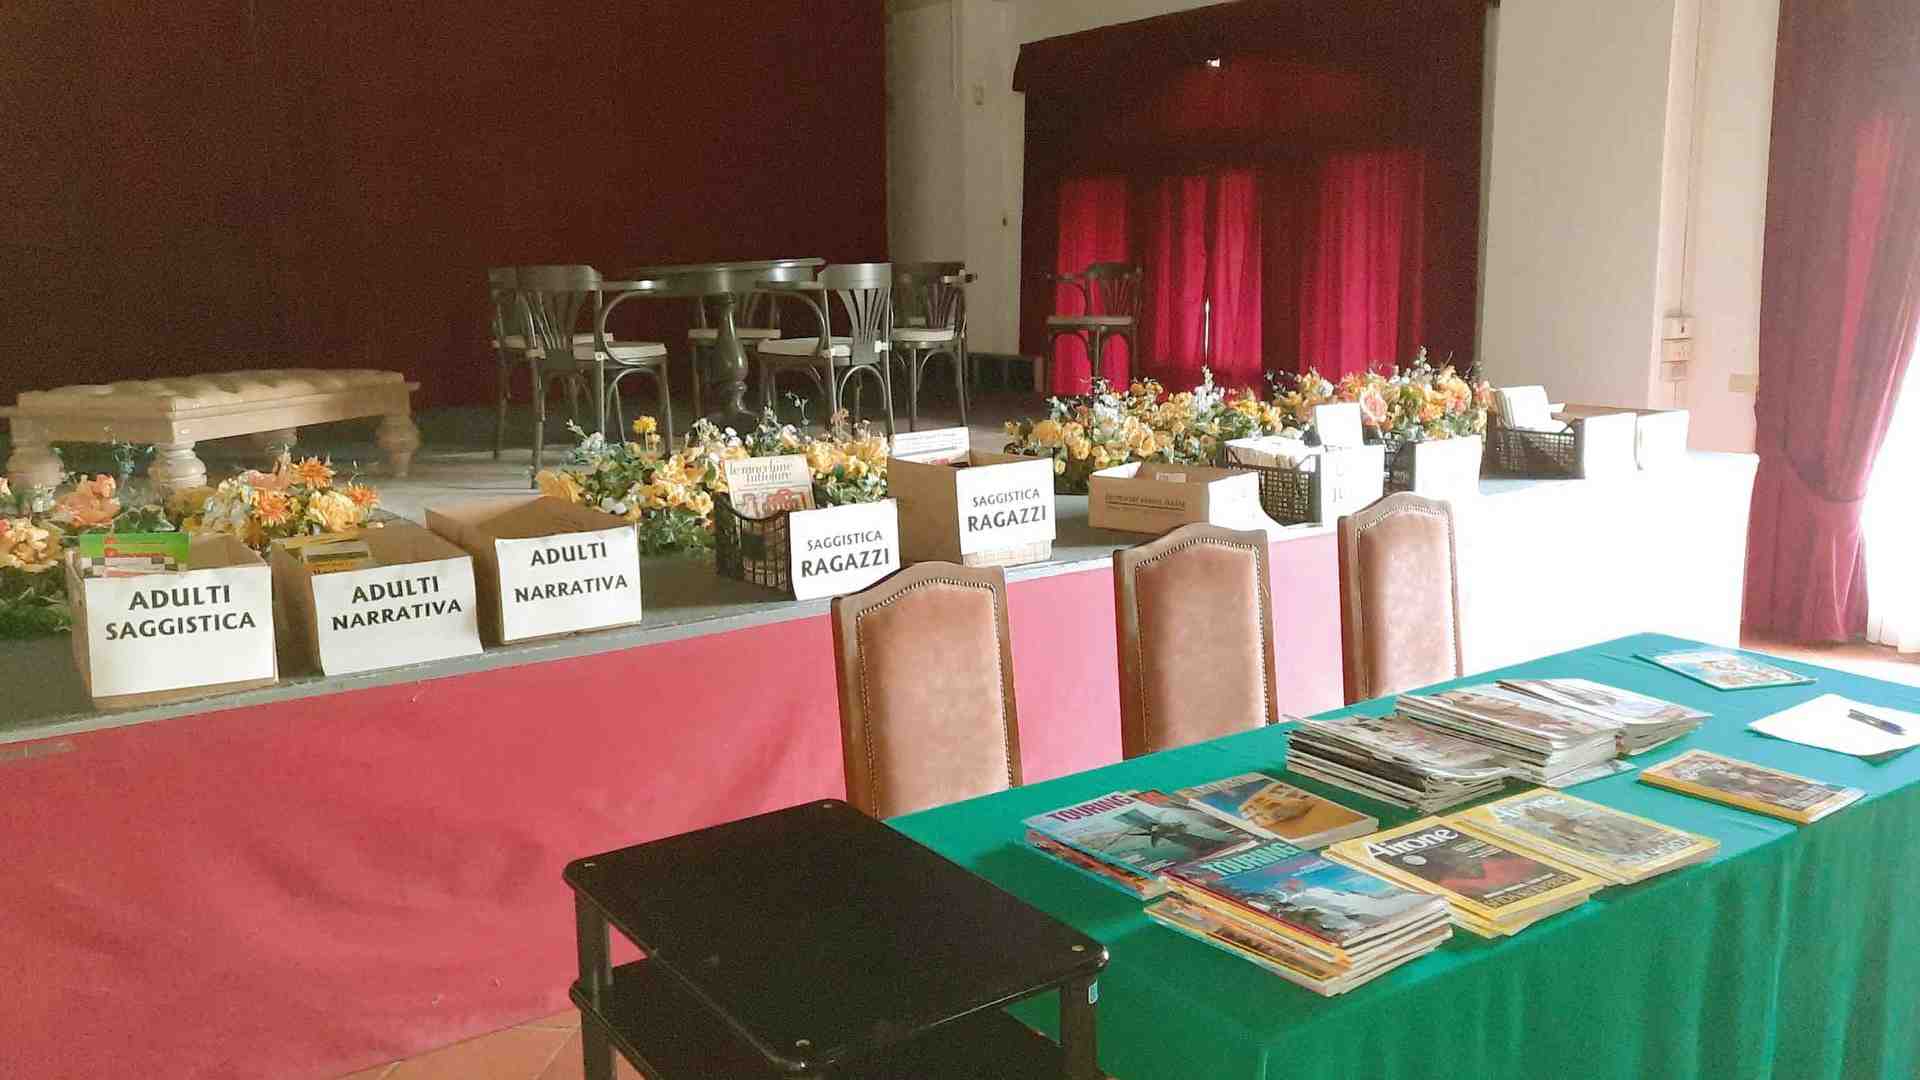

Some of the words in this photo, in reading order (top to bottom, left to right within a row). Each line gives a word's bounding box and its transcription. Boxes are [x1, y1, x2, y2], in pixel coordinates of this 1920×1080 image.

[973, 488, 1040, 507] SAGGISTICA
[967, 505, 1047, 533] RAGAZZI
[531, 542, 608, 566] ADULTI
[807, 530, 882, 551] SAGGISTICA
[801, 548, 889, 578] RAGAZZI
[128, 585, 231, 611] ADULTI
[351, 576, 439, 604] ADULTI
[514, 575, 628, 603] NARRATIVA
[105, 612, 256, 641] SAGGISTICA
[332, 599, 462, 631] NARRATIVA
[1047, 795, 1135, 822] TOURING
[1363, 828, 1459, 859] Airone
[1201, 842, 1300, 876] TOURING
